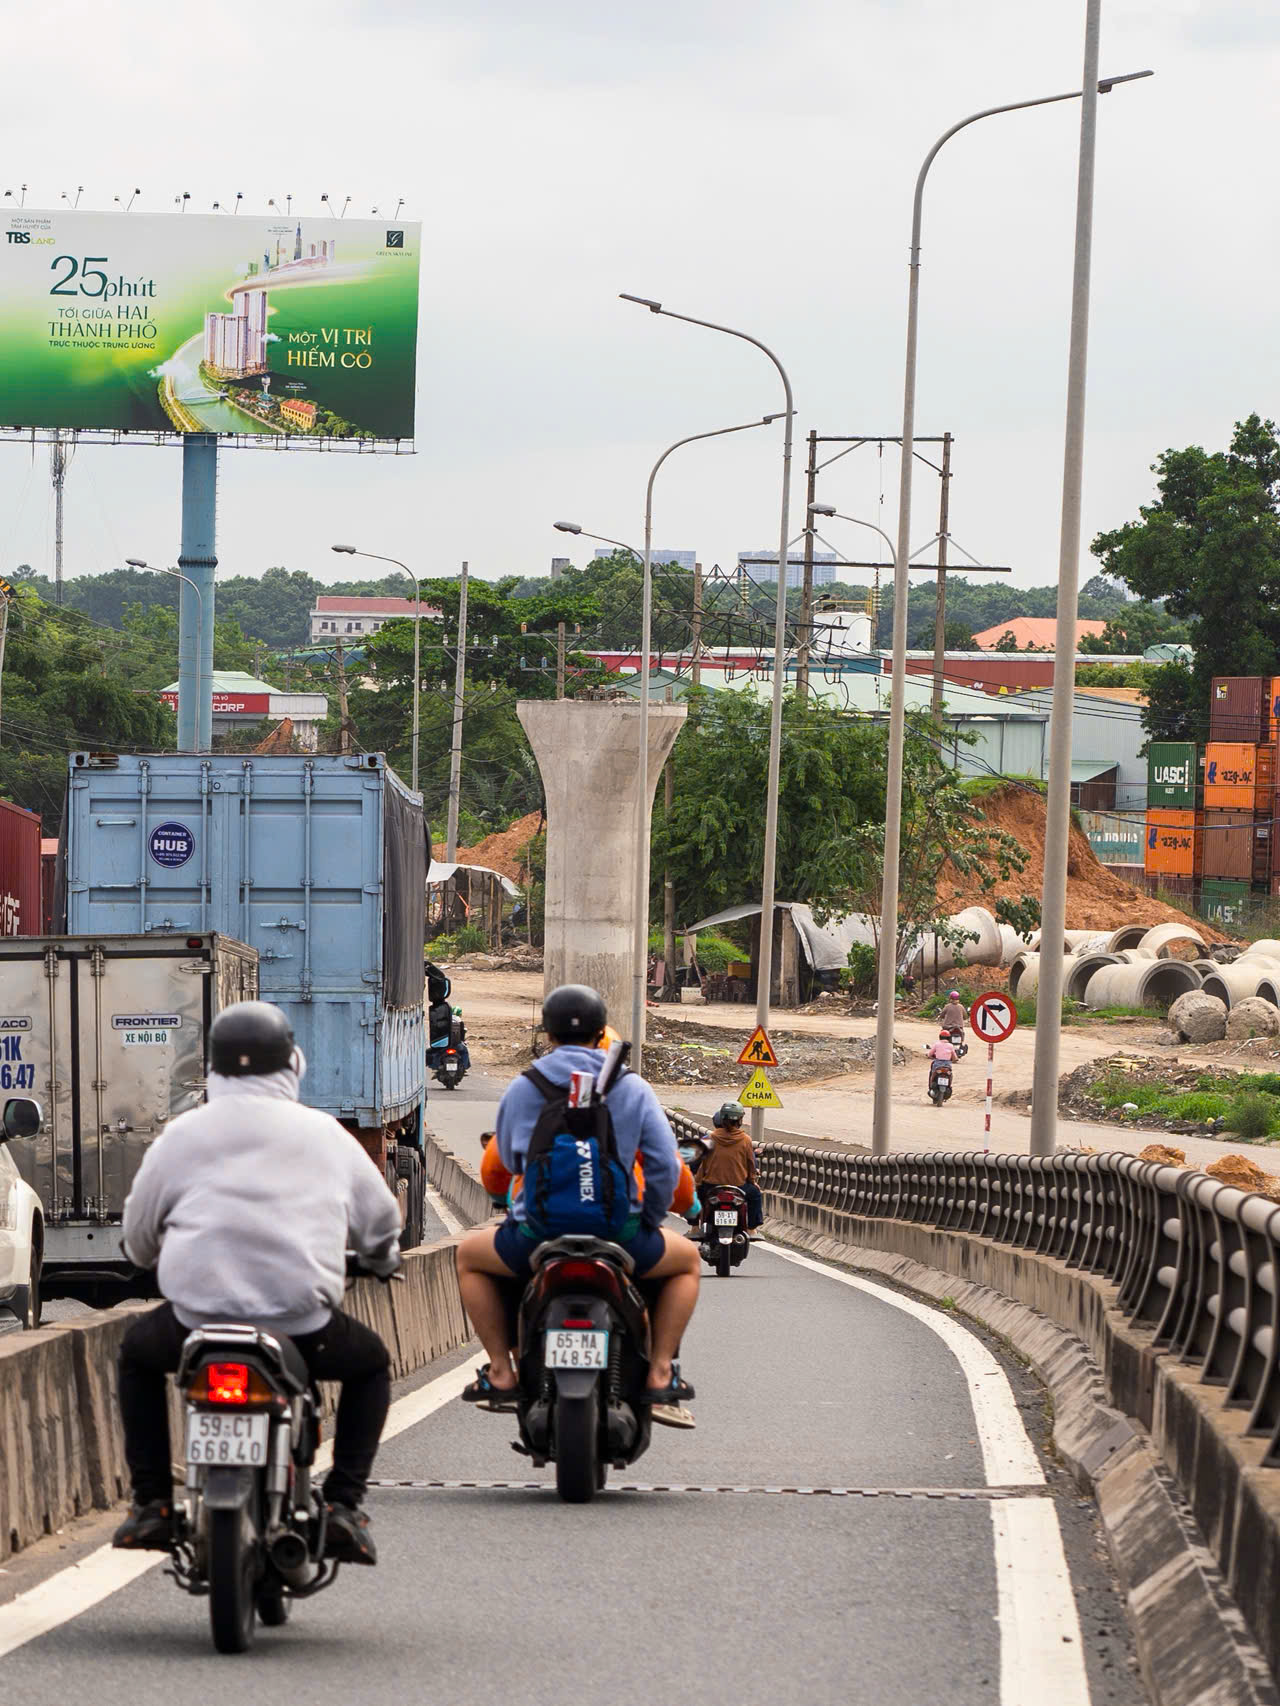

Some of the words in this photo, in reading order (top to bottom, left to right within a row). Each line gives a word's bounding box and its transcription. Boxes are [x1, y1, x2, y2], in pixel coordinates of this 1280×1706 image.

[6, 232, 30, 244] TBS
[50, 255, 108, 297] 25
[104, 276, 157, 302] phút
[58, 307, 78, 319] TỚI
[82, 308, 112, 320] GIỮA
[118, 305, 148, 320] HAI
[48, 319, 112, 338] THÀNH
[117, 318, 157, 339] PHỐ
[48, 340, 70, 348] TRỰC
[72, 340, 100, 349] THUỘC
[103, 341, 130, 349] TRUNG
[132, 341, 156, 350] ƯƠNG
[288, 332, 318, 346] MỘT
[321, 328, 339, 348] VỊ
[343, 326, 373, 345] TRÍ
[288, 344, 335, 368] HIẾM
[340, 349, 372, 369] CÓ
[212, 703, 245, 712] CORP
[154, 839, 188, 852] HUB
[115, 1016, 179, 1026] FRONTIER
[125, 1033, 136, 1043] XE
[138, 1031, 153, 1045] NỘI
[155, 1030, 167, 1044] BỘ
[754, 1081, 764, 1089] ĐI
[579, 1161, 595, 1202] YONEX
[556, 1332, 598, 1350] 65-MA
[551, 1350, 603, 1368] 148.54
[200, 1416, 253, 1438] 59-C1
